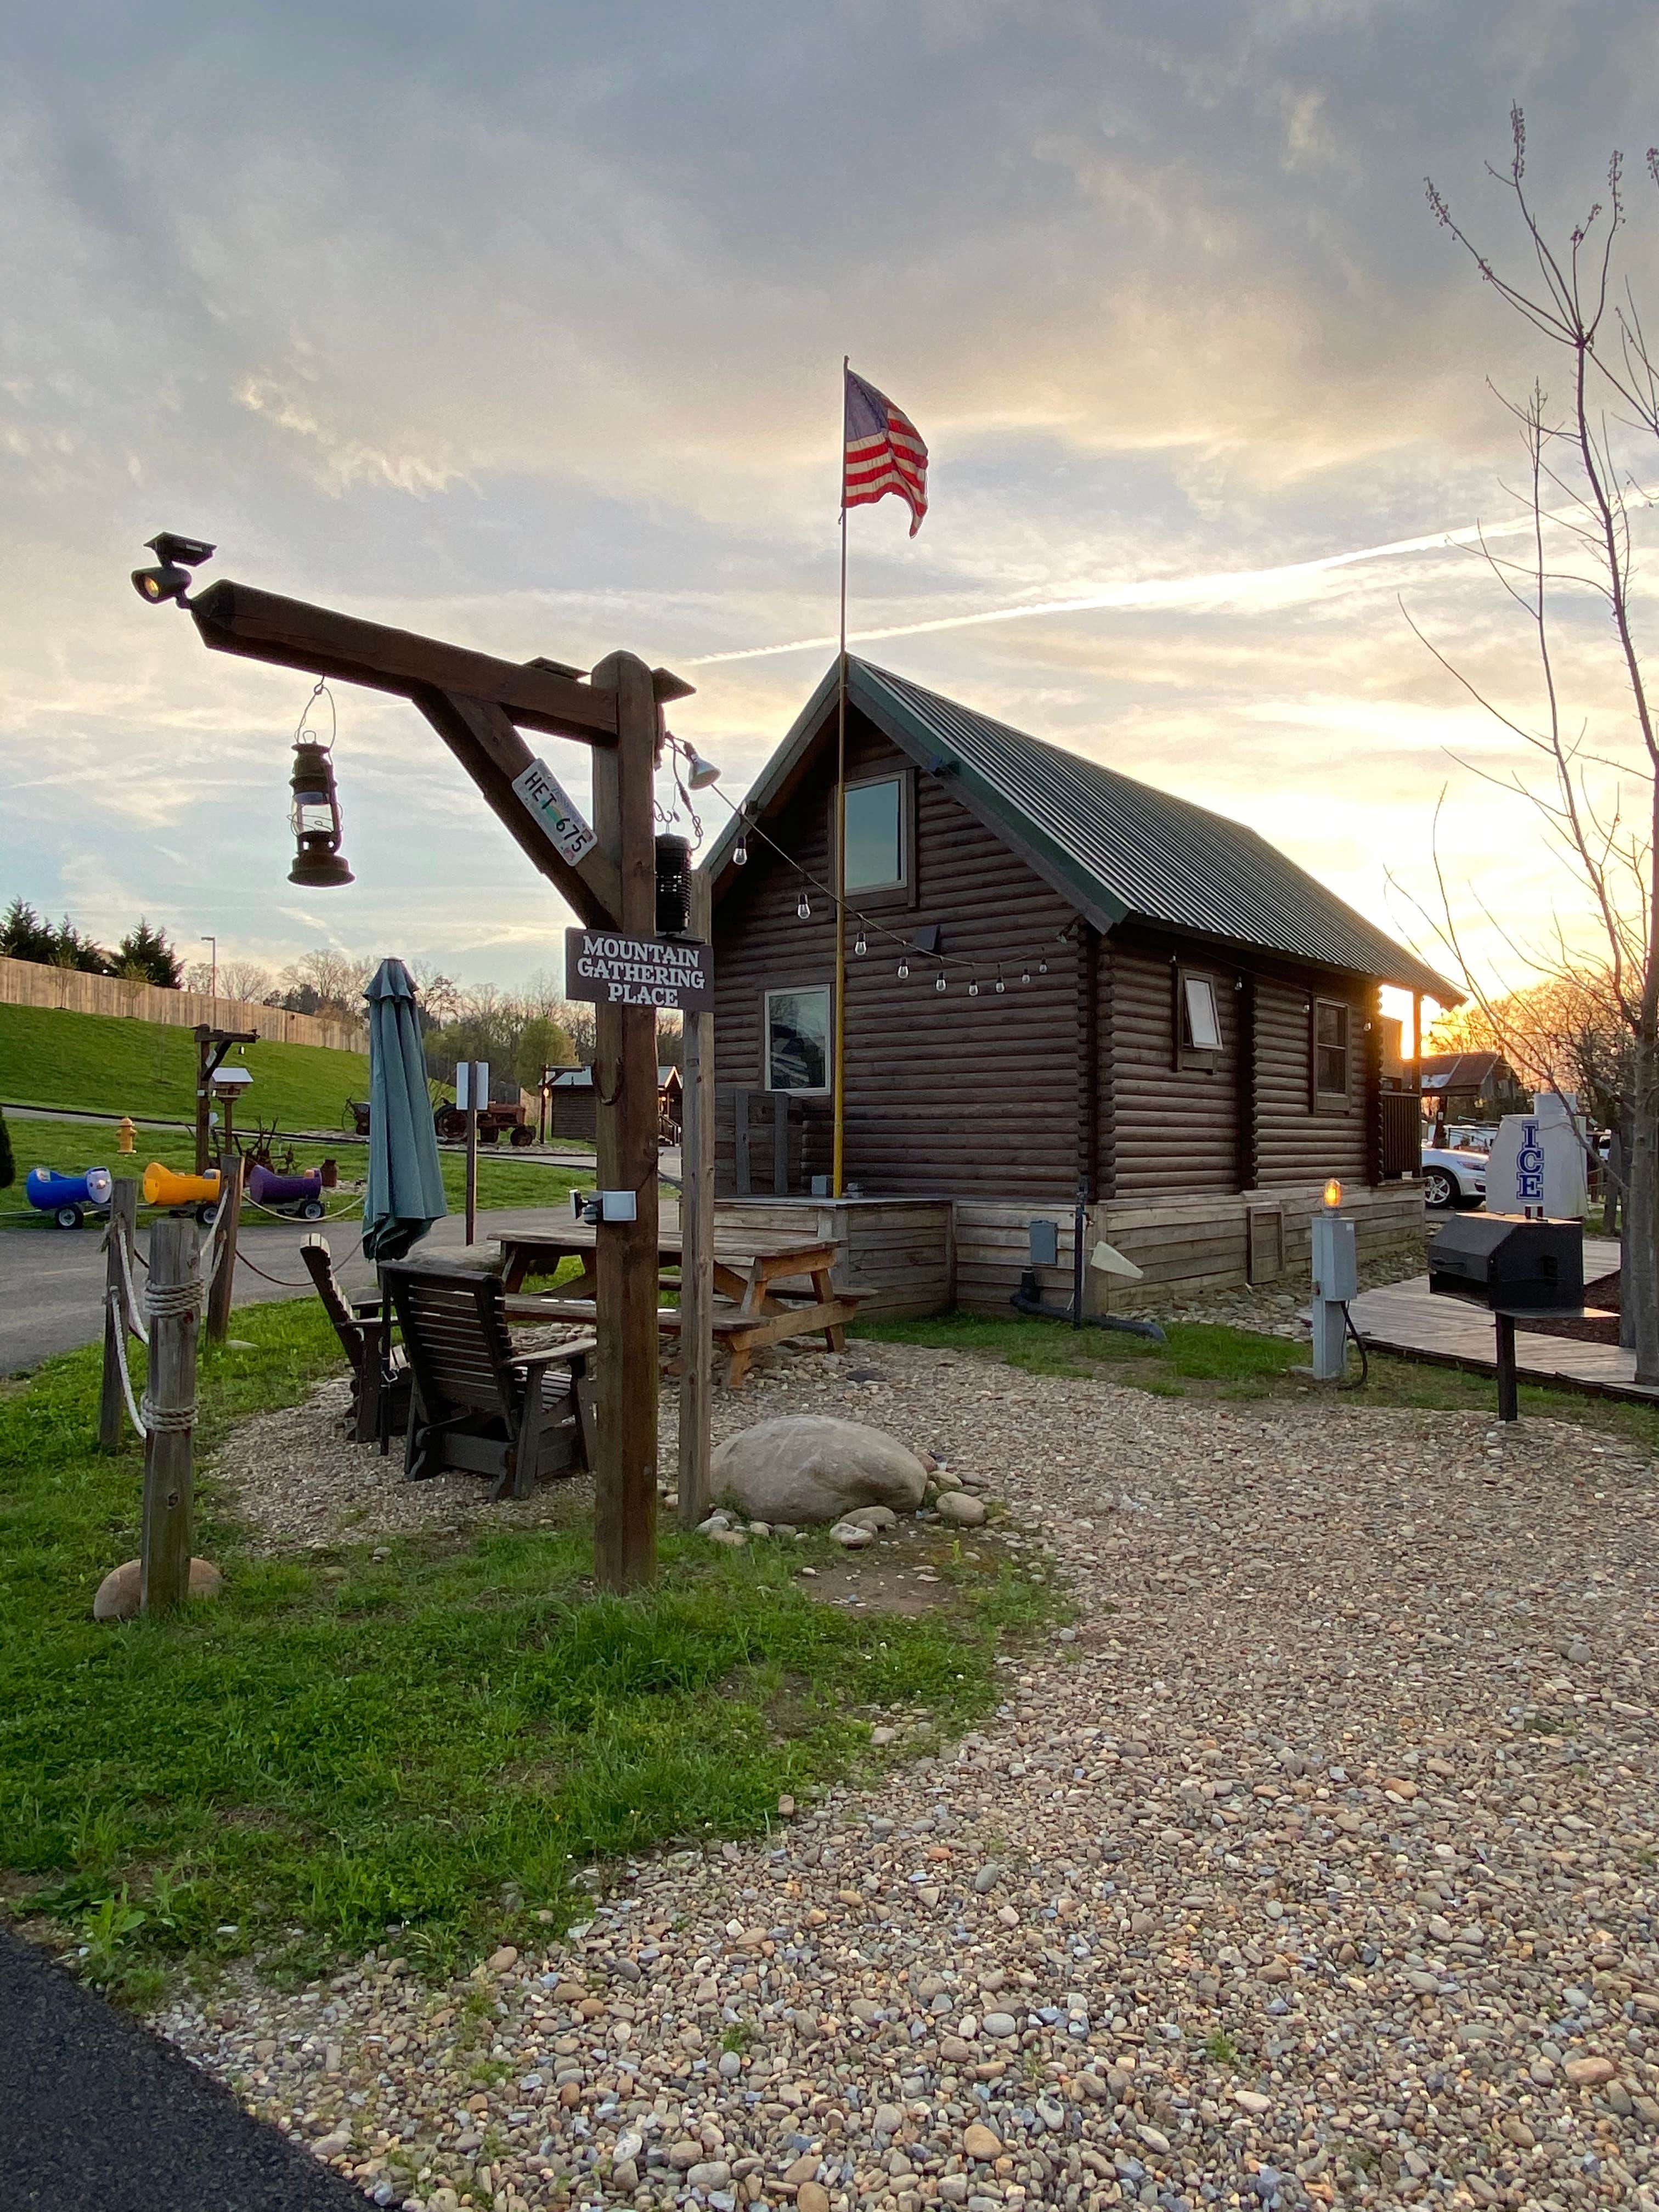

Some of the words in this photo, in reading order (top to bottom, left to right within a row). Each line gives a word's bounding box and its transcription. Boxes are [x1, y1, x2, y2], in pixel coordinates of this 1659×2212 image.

[524, 771, 557, 809] HET
[556, 818, 587, 852] 675
[583, 935, 699, 968] MOUNTAIN
[577, 957, 705, 989] GATHERING
[608, 983, 678, 1007] PLACE
[1517, 1120, 1544, 1200] ICE
